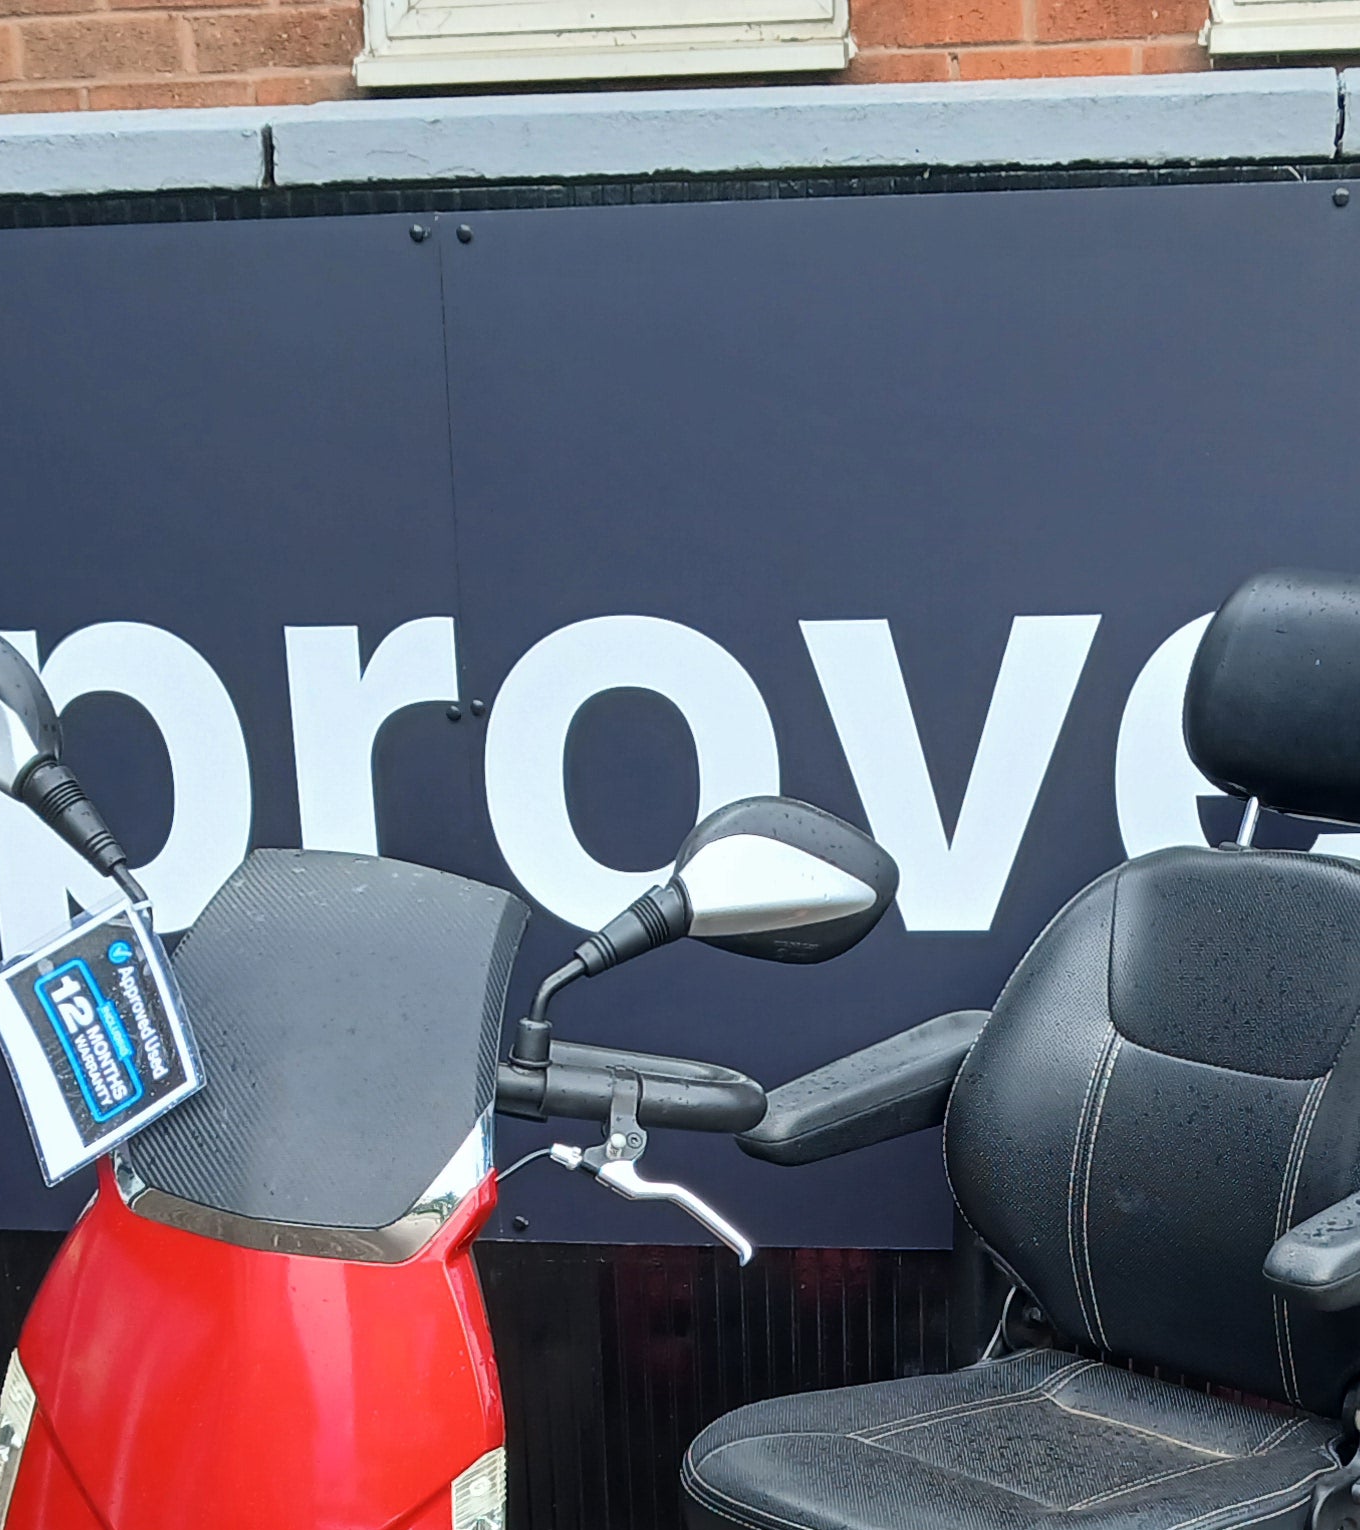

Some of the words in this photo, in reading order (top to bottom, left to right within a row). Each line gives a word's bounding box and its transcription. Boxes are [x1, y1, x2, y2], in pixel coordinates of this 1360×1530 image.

[51, 975, 94, 1034] 12
[118, 966, 156, 1040] Approved
[144, 1035, 169, 1080] Used
[74, 1033, 114, 1106] WARRANTY
[86, 1024, 128, 1101] MONTHS
